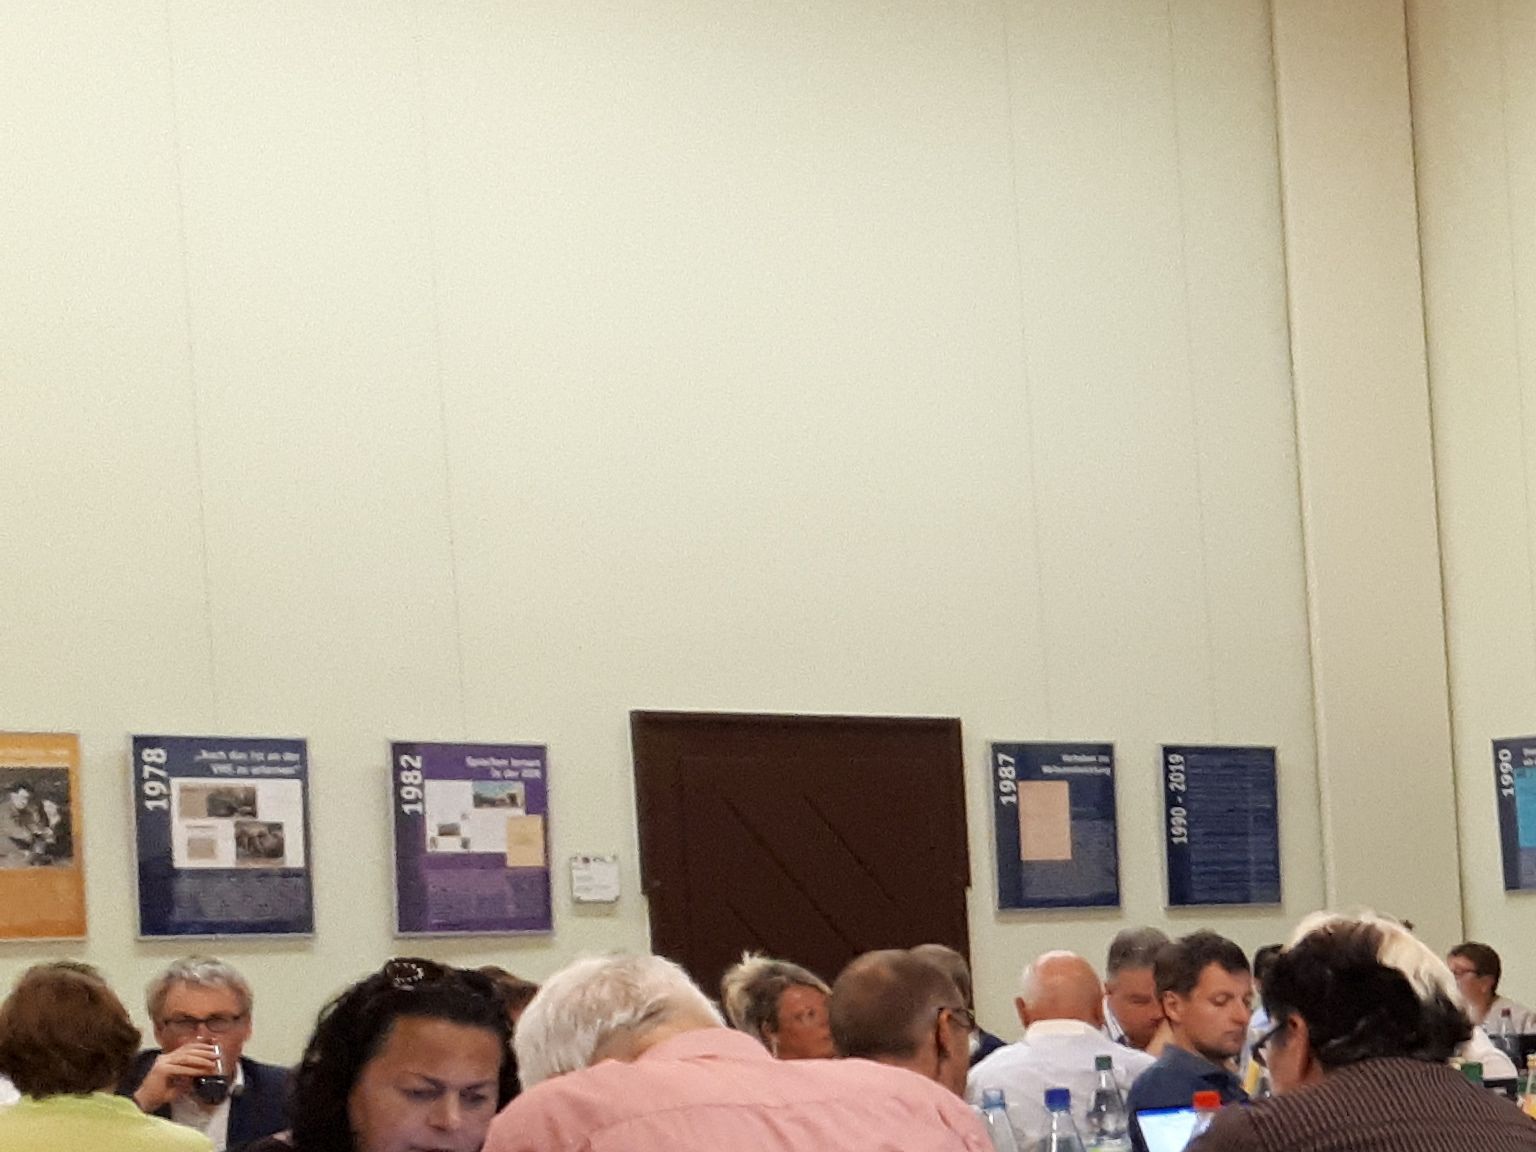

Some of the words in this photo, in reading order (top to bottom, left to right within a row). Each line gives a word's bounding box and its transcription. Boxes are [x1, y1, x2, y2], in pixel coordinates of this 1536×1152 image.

[141, 748, 169, 811] 1978
[400, 754, 424, 815] 1982
[997, 753, 1017, 805] 1987
[1167, 753, 1187, 792] 2019
[1498, 748, 1514, 798] 1990
